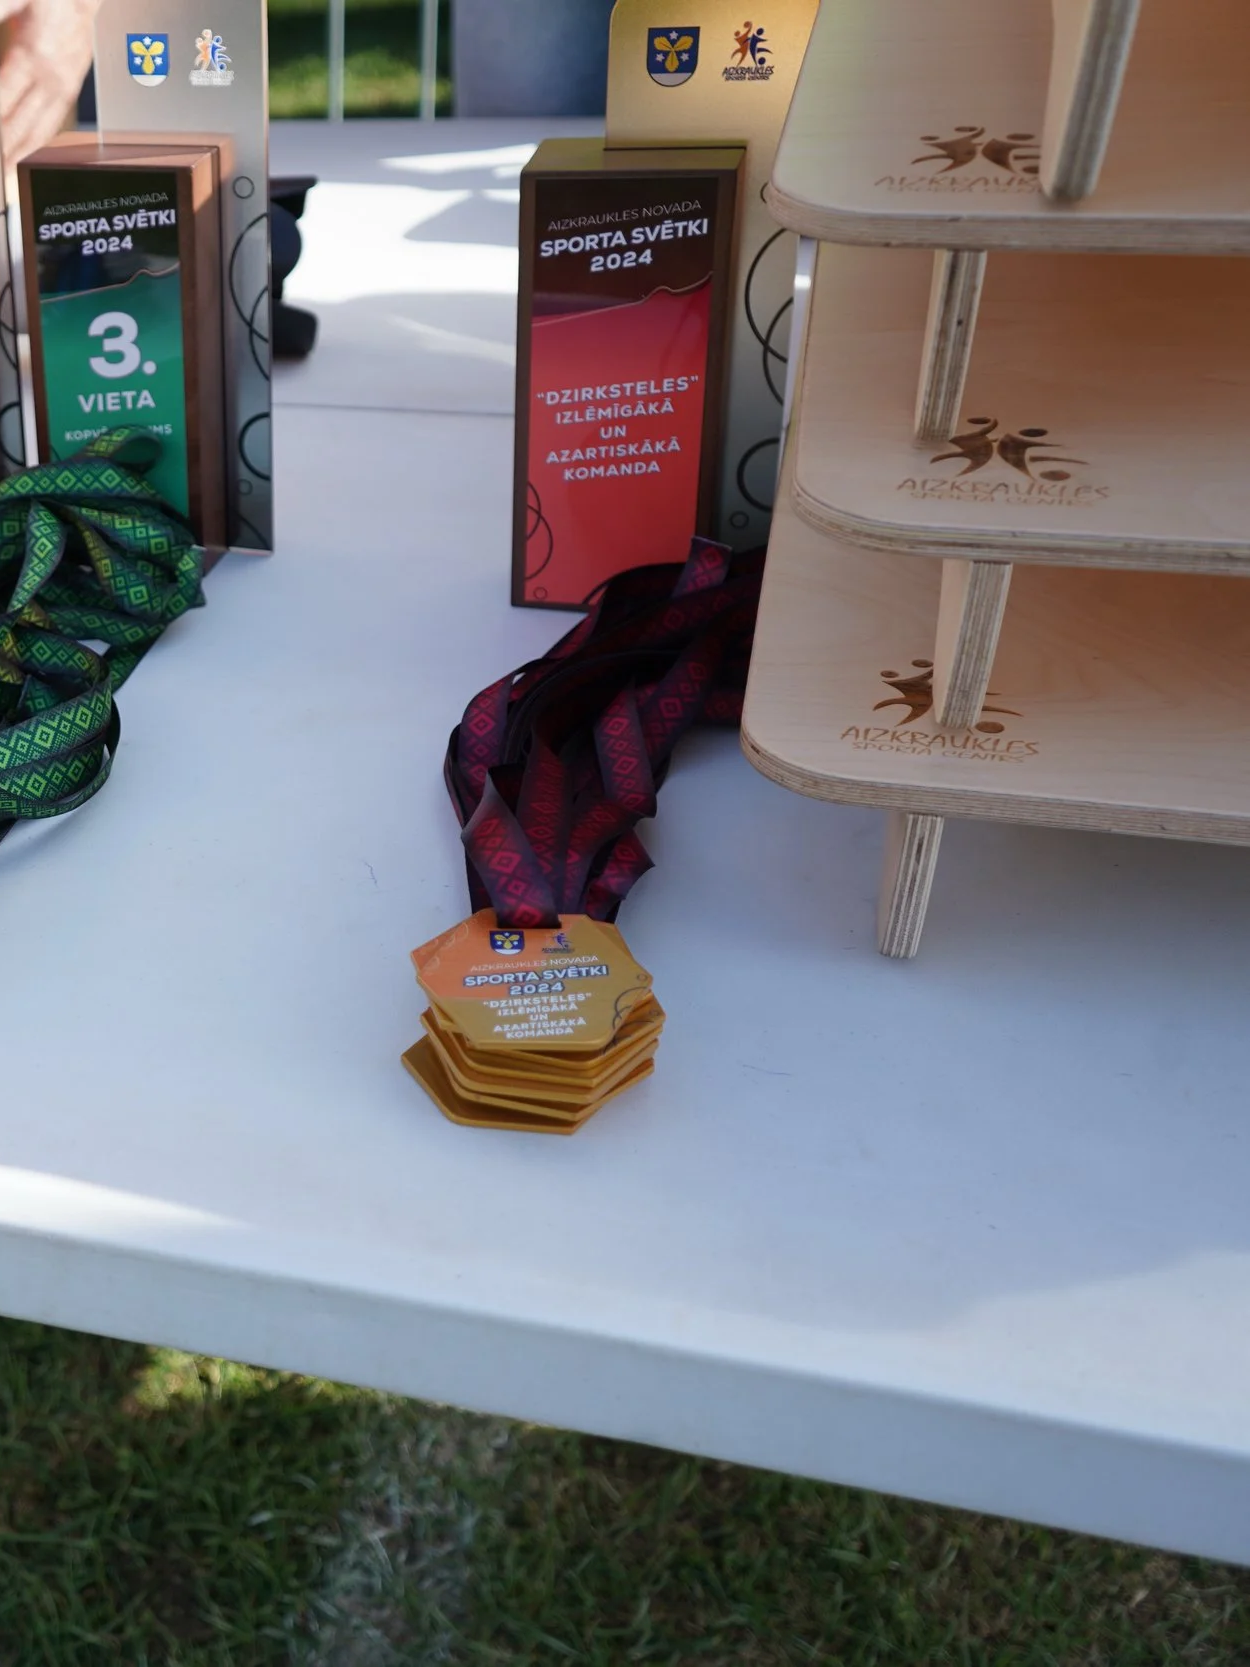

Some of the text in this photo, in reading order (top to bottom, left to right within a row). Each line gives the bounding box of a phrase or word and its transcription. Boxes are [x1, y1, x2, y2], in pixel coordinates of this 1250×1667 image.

[43, 191, 169, 217] AIZKRAUKLES NOVADA
[547, 199, 702, 232] AIZKRAUKLES NOVADA
[38, 208, 177, 241] SPORTA SVĒTKI
[81, 234, 134, 256] 2024
[540, 217, 709, 258] SPORTA SVĒTKI
[590, 248, 653, 272] 2024
[87, 311, 157, 379] 3.
[77, 389, 156, 414] VIETA
[555, 398, 675, 425] IZLĒMĪGĀKĀ
[600, 425, 627, 440] UN
[546, 437, 681, 464] AZARTISKĀKĀ
[563, 460, 661, 481] KOMANDA
[840, 725, 1040, 756] AIZKRAUKLES
[470, 955, 599, 973] AIZKRAUKLES NOVADA
[464, 965, 609, 987] SPORTA SVĒTKI
[509, 982, 564, 996] 2024
[497, 1002, 578, 1017] IZLĒMĪGĀKĀ
[529, 1013, 548, 1021] UN
[493, 1017, 587, 1033] AZARTISKĀKĀ
[505, 1027, 574, 1039] KOMANDA
